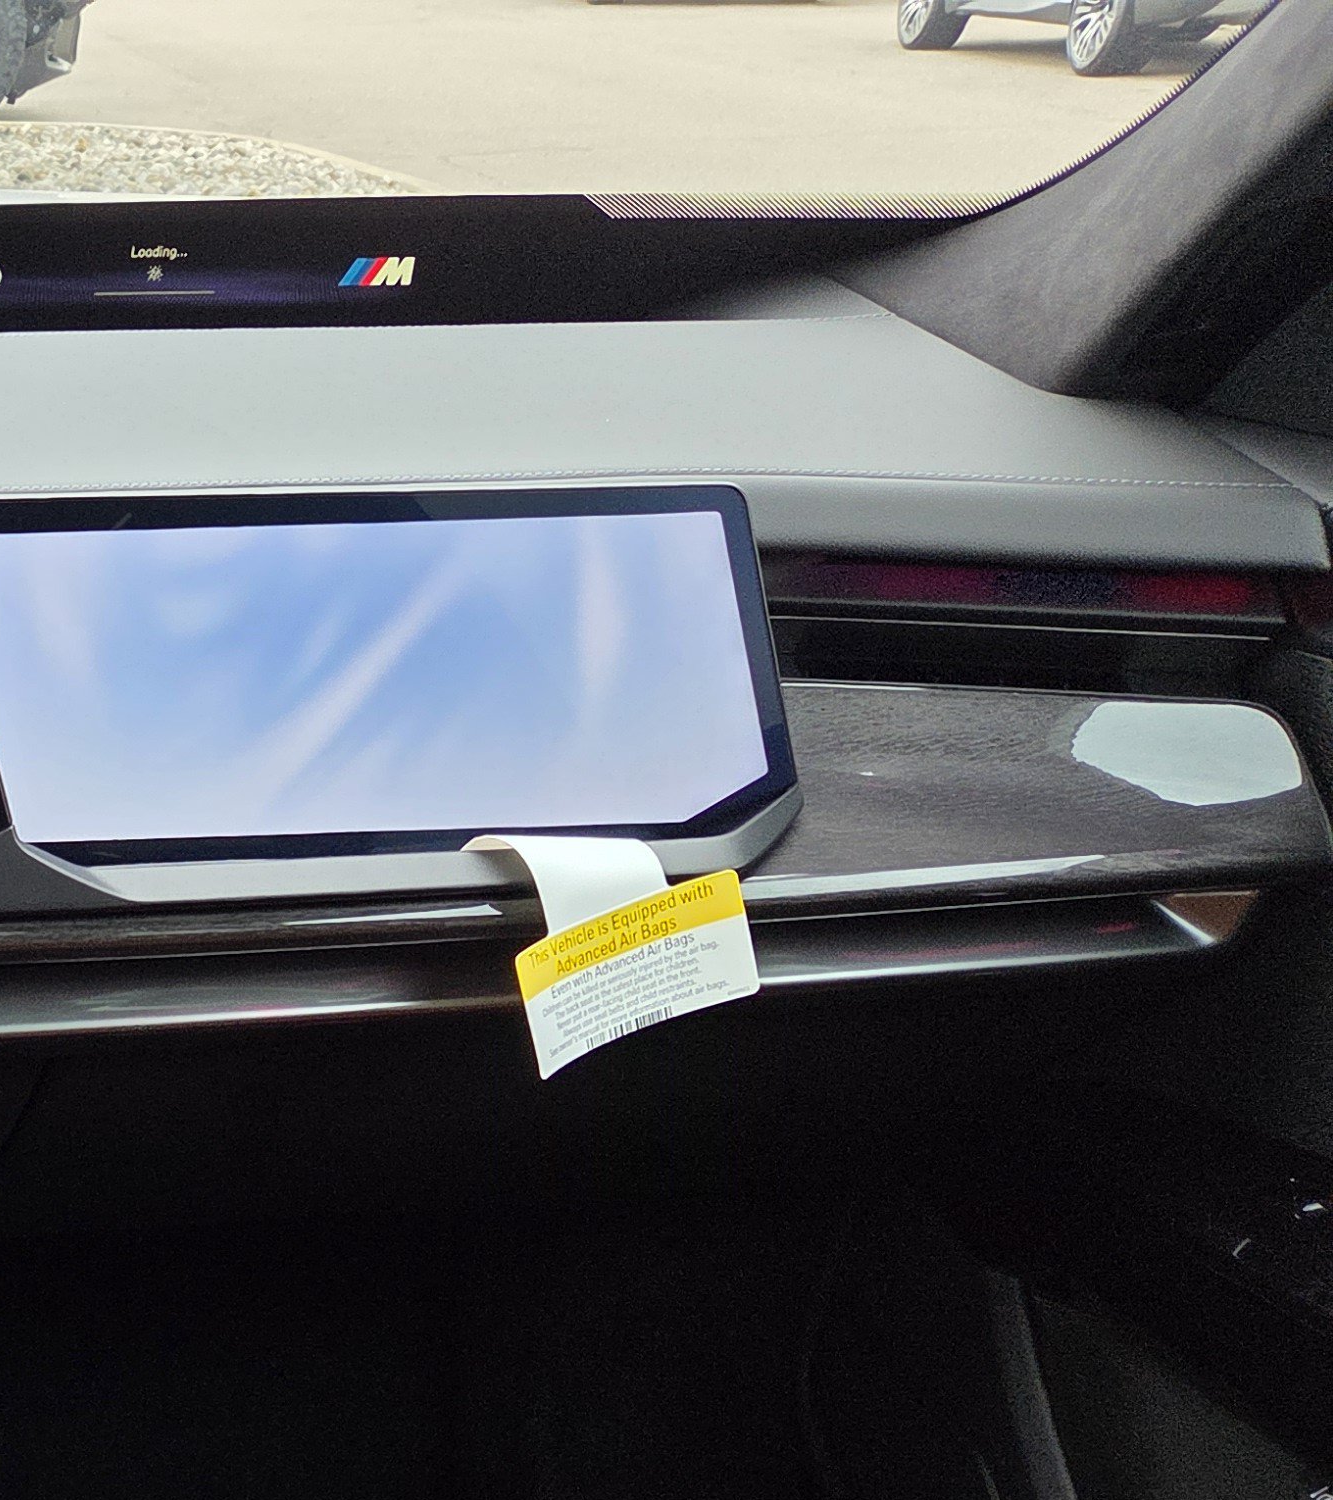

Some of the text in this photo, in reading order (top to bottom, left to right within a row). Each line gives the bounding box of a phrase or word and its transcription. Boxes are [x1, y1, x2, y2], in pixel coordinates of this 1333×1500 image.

[130, 245, 189, 261] Loading...
[528, 881, 714, 969] This Vehicle is Equipped with
[556, 917, 677, 976] Advanced Air Bags
[638, 957, 663, 972] injured
[664, 955, 673, 964] by
[674, 950, 687, 960] the
[689, 944, 699, 955] air
[551, 933, 695, 999] Even with Advanced Air Bags
[634, 972, 653, 985] place
[654, 968, 664, 977] for
[624, 985, 641, 998] child
[642, 981, 657, 992] seat
[666, 973, 678, 983] the
[671, 988, 694, 1002] about
[695, 985, 705, 995] air
[626, 996, 639, 1008] and
[640, 990, 657, 1003] child
